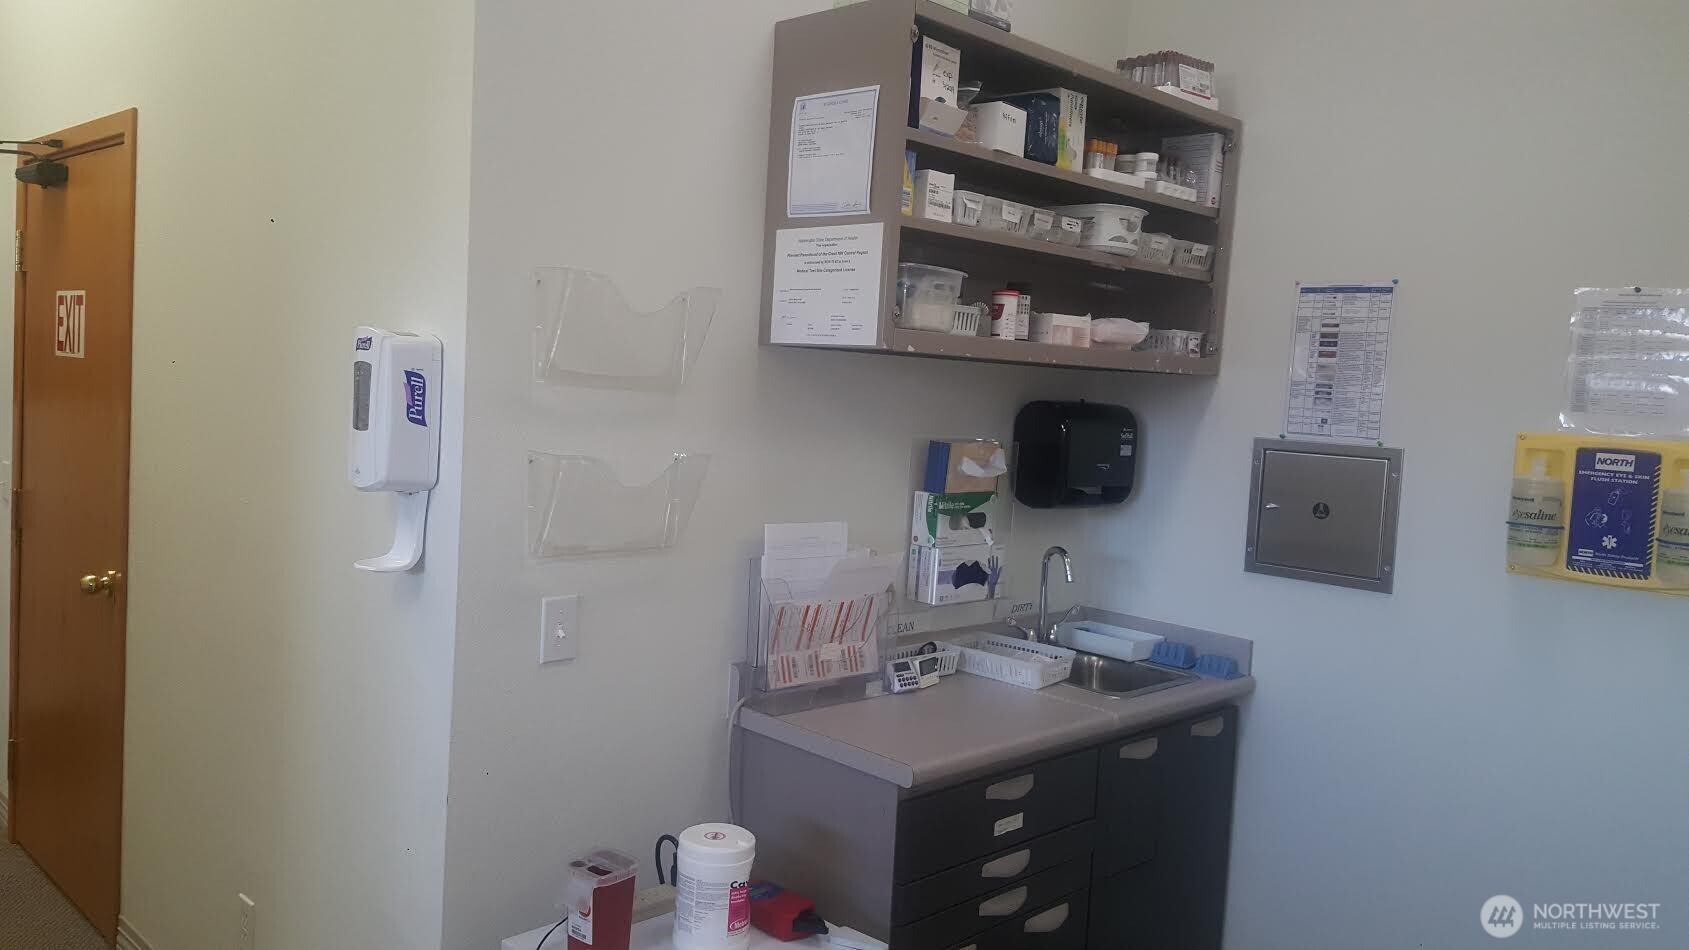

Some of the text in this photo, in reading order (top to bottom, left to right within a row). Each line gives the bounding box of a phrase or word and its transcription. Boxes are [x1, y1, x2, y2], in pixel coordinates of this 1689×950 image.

[57, 294, 83, 354] EXIT
[409, 376, 425, 420] Purell
[1578, 470, 1614, 478] EMERGENCY
[1596, 457, 1634, 467] NORTH
